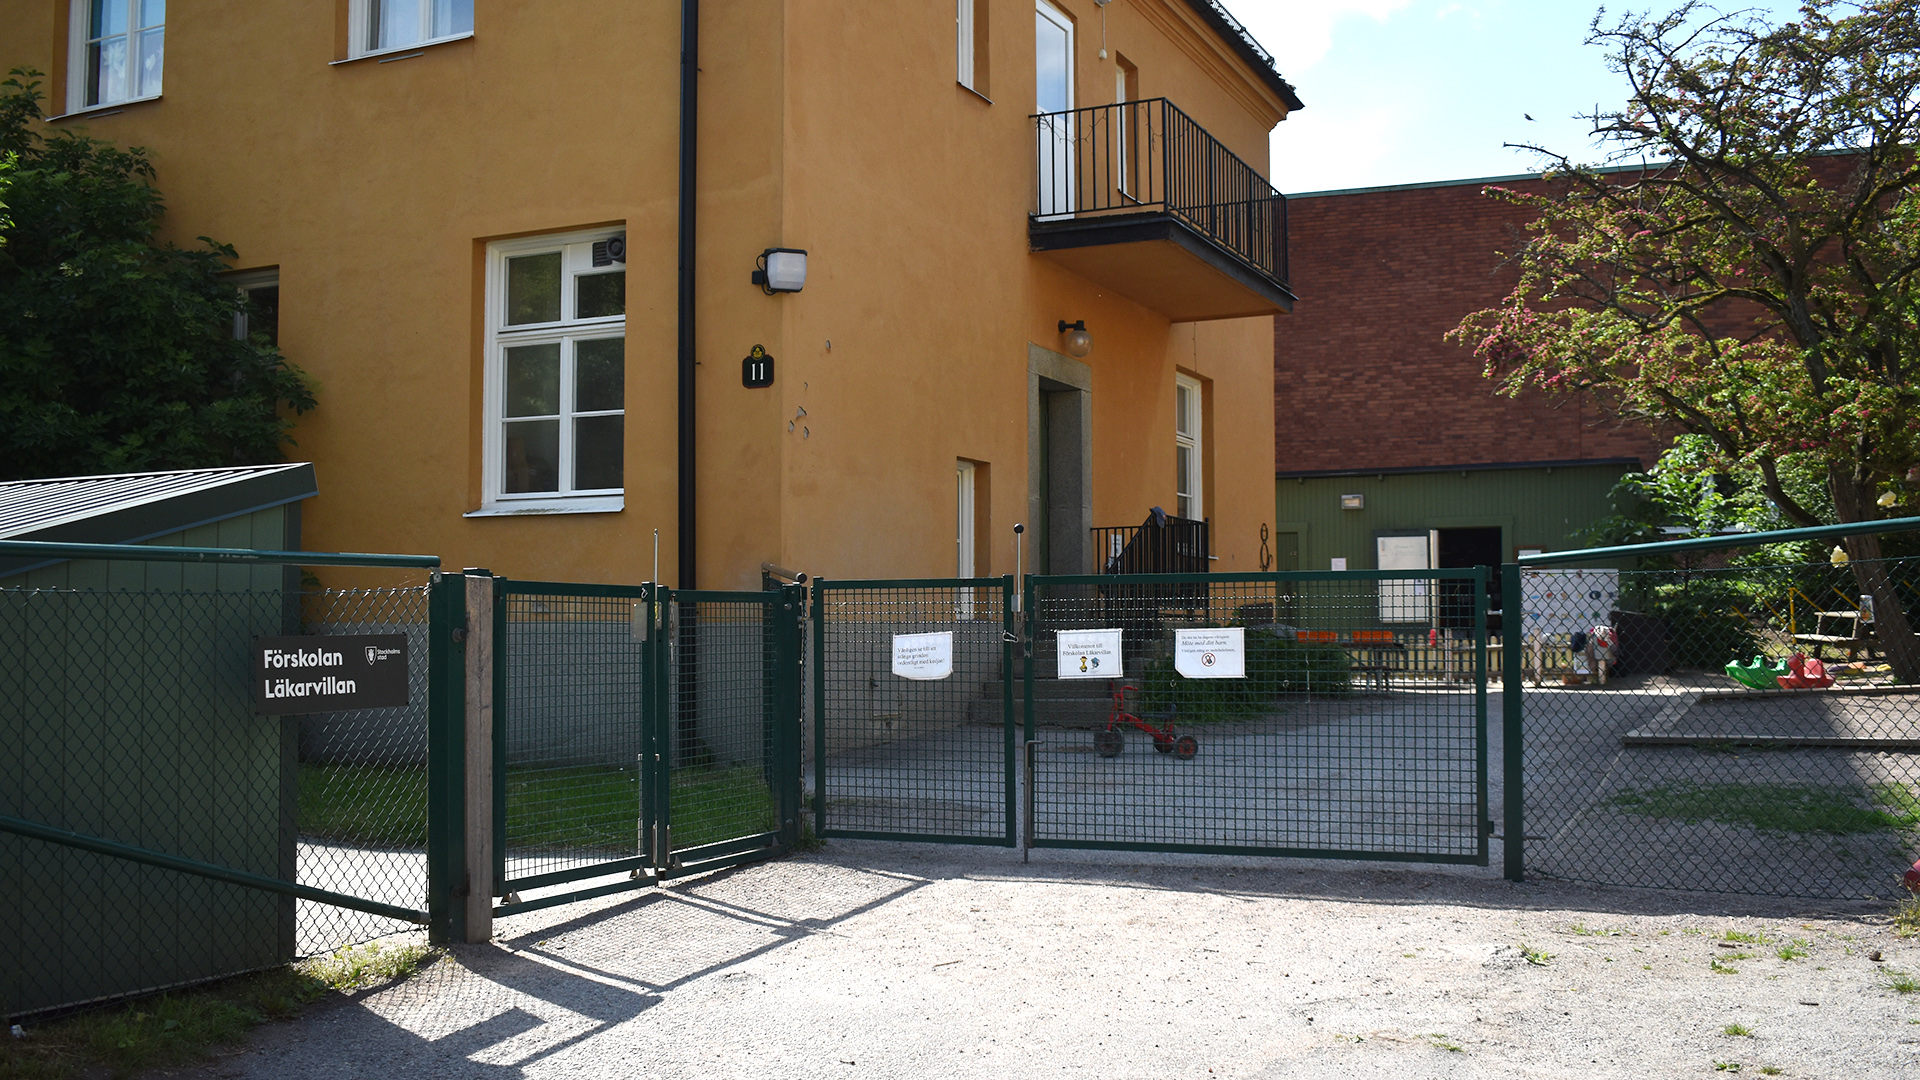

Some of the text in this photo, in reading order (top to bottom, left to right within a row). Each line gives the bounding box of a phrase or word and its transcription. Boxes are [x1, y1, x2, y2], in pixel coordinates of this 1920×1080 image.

[752, 362, 764, 380] 11
[264, 648, 343, 668] Förskolan
[265, 676, 356, 699] Läkarvillan
